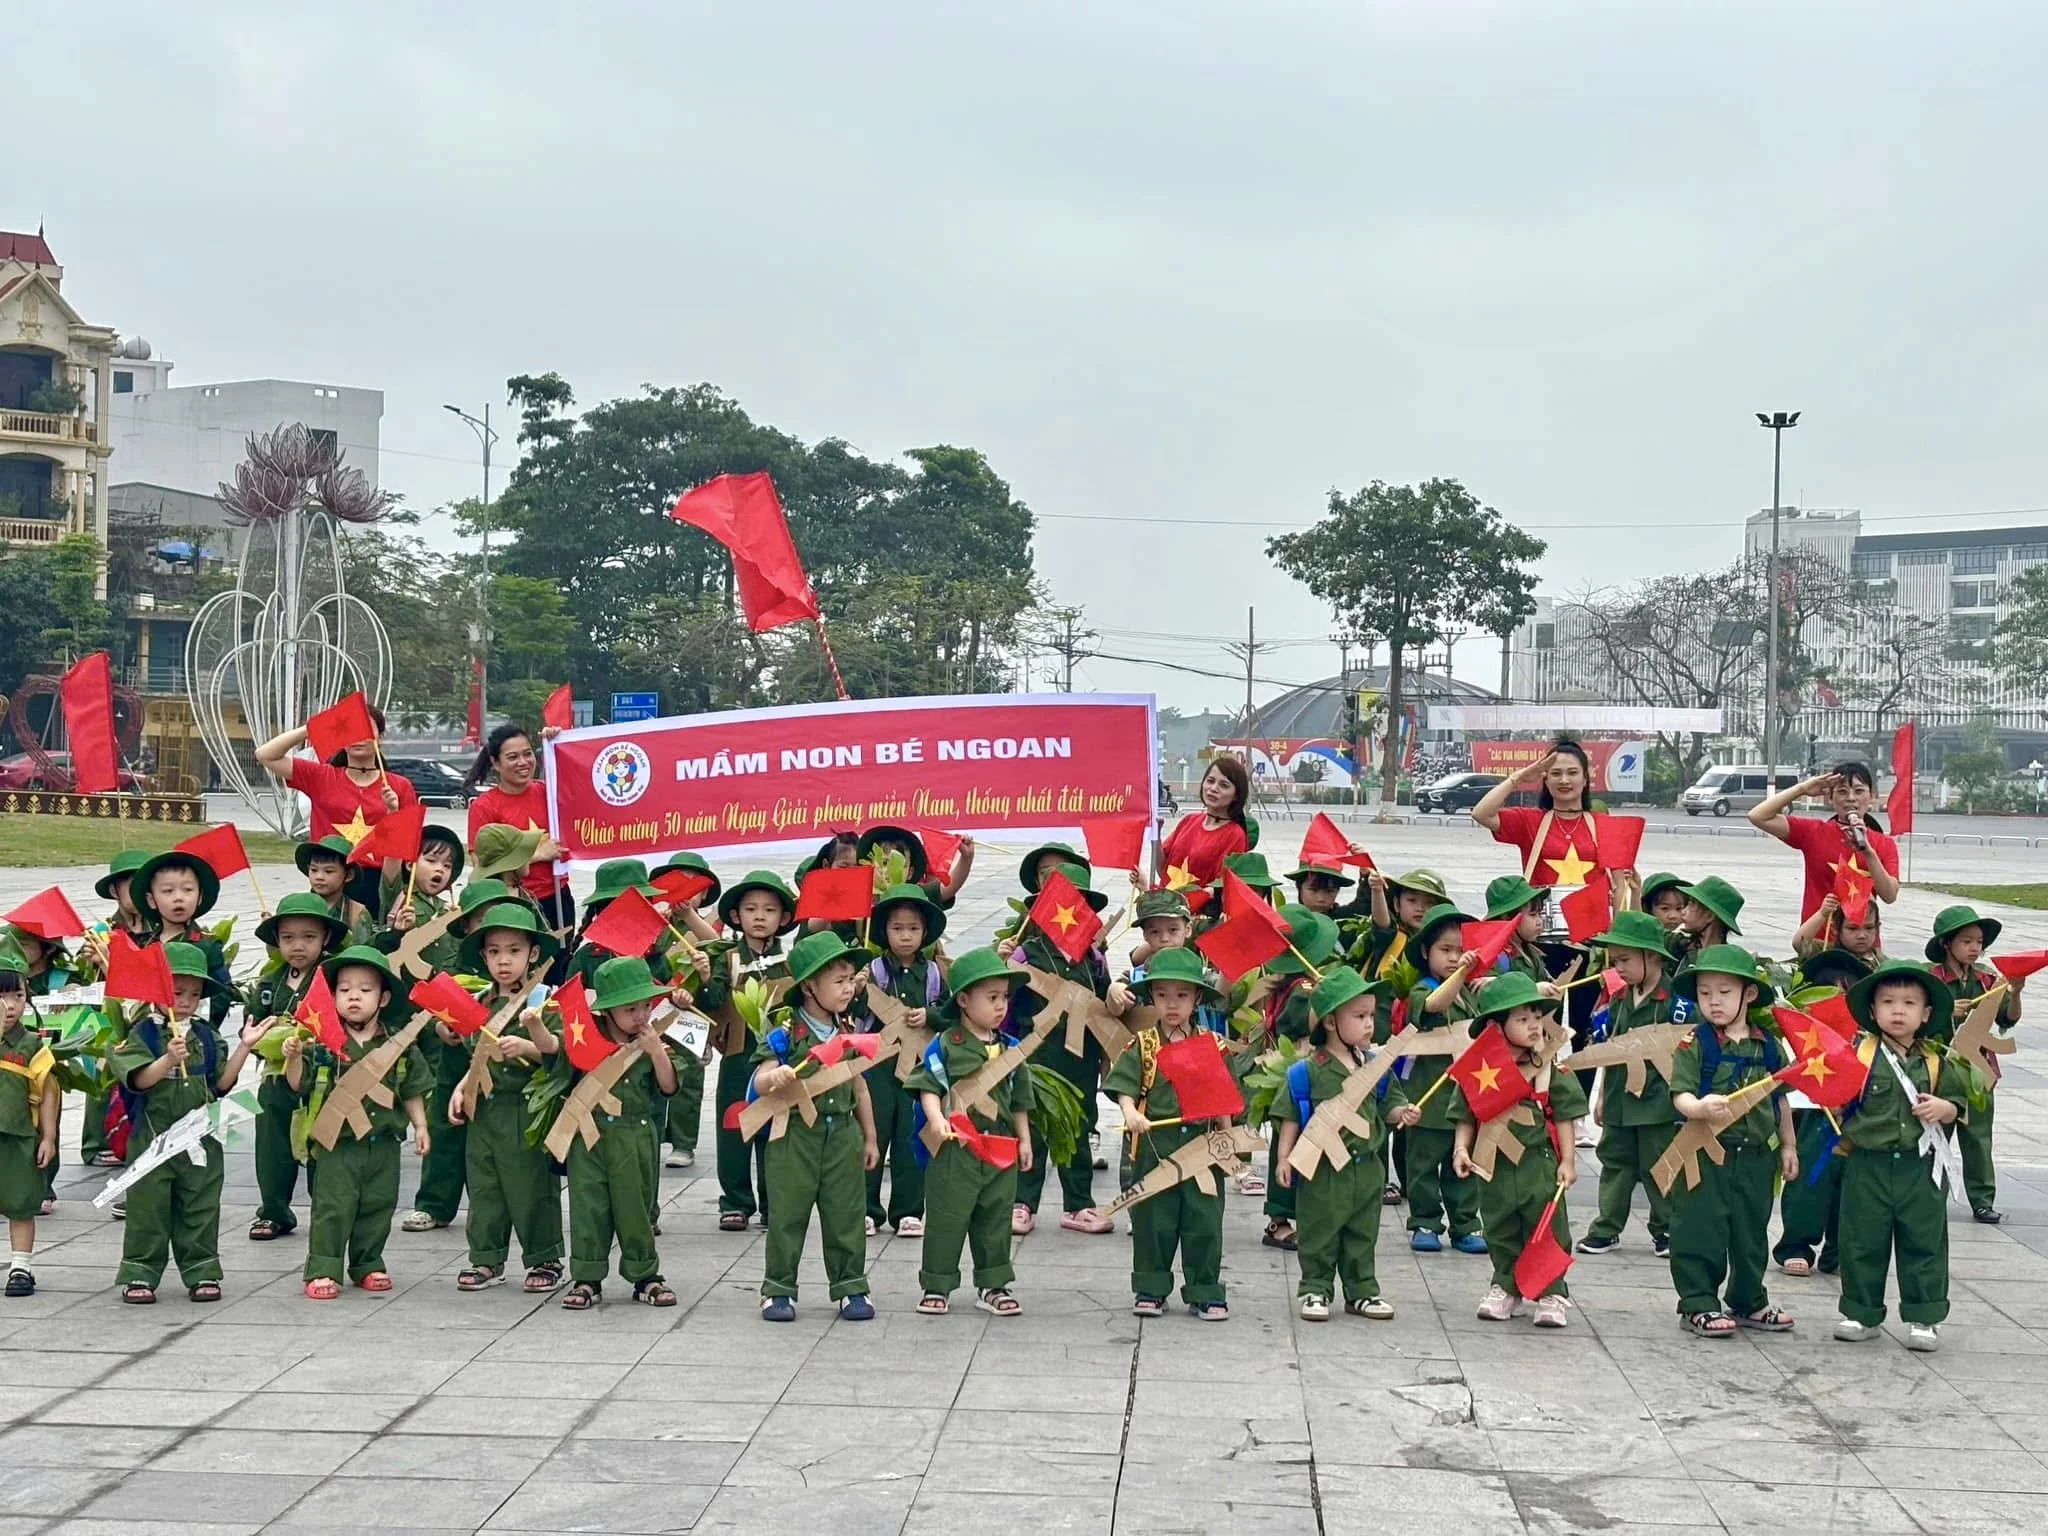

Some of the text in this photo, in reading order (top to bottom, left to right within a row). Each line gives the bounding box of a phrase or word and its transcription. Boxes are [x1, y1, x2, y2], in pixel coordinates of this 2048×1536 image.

[675, 736, 1072, 781] MẦM NON BÉ NGOAN
[620, 816, 660, 845] mừng
[663, 810, 682, 837] 50
[685, 809, 718, 835] năm
[722, 801, 767, 836] Ngày
[773, 797, 808, 834] Giải
[813, 793, 863, 831] phóng
[868, 788, 907, 819] miền
[912, 786, 960, 821] Nam,
[965, 785, 1010, 820] thống
[1016, 785, 1052, 812] nhất
[1057, 784, 1085, 813] đất
[1215, 1140, 1229, 1153] 20
